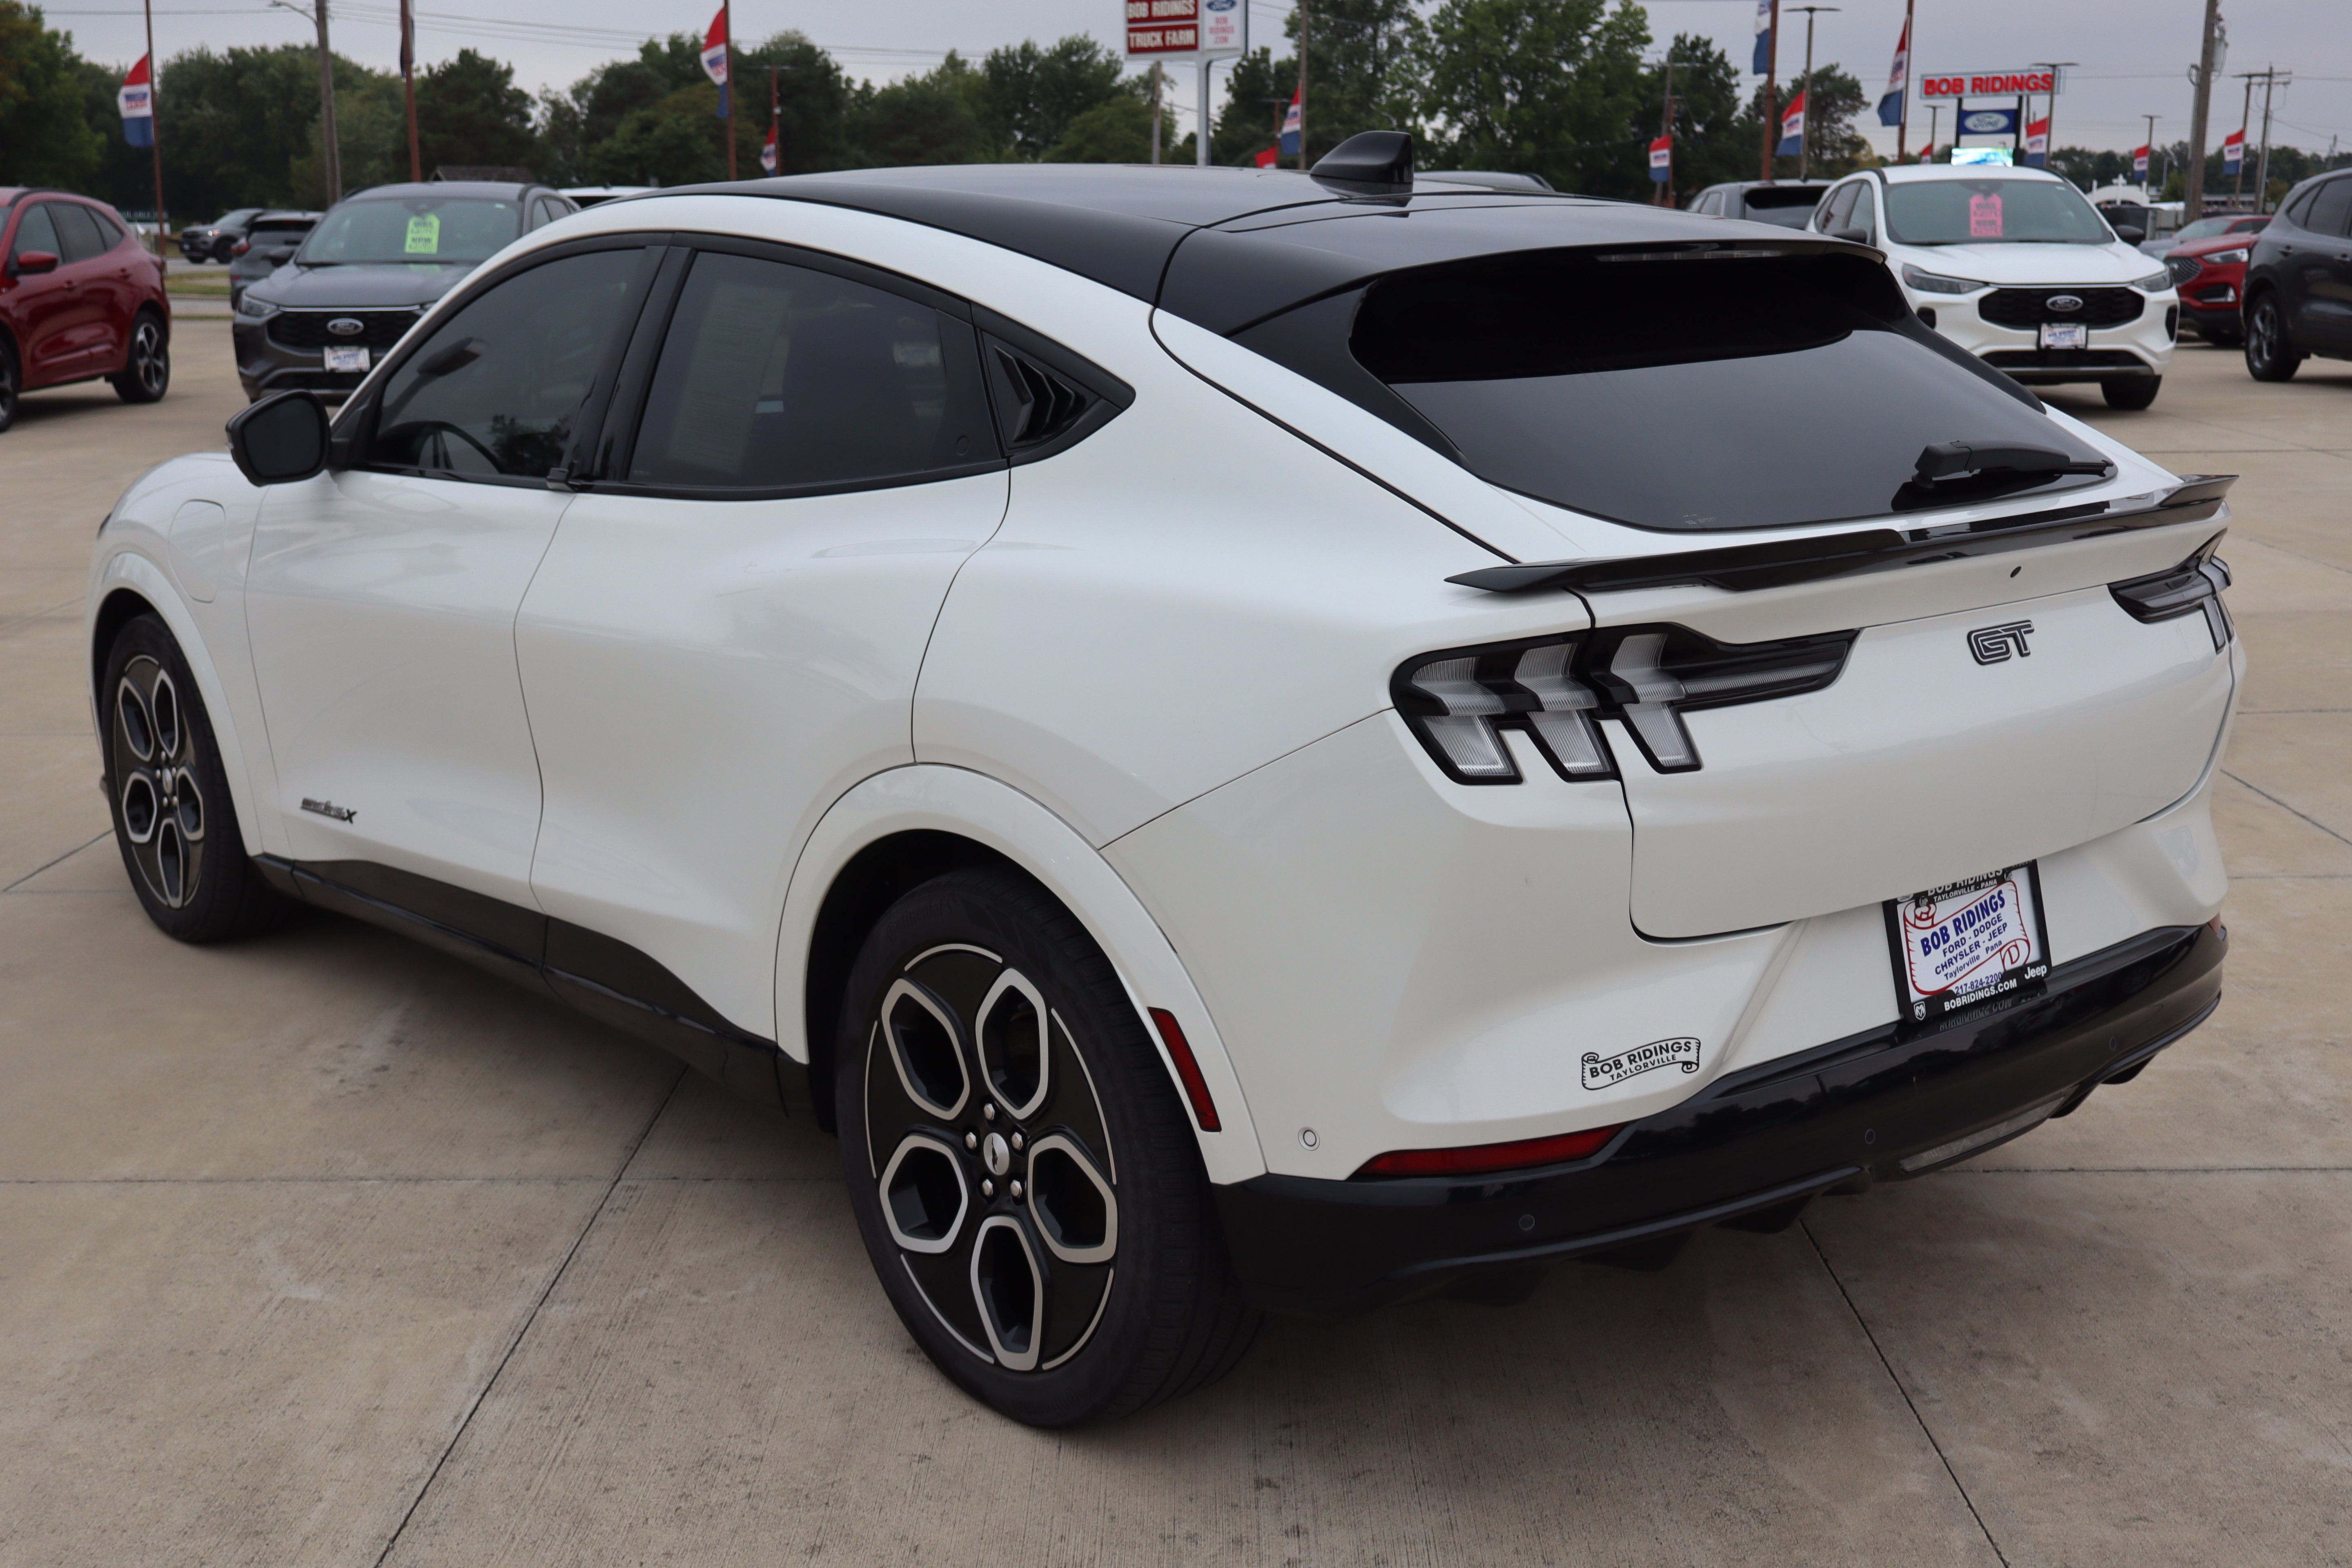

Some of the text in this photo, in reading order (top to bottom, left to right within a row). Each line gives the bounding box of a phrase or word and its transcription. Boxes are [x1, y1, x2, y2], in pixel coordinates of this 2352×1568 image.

[1128, 0, 1196, 19] BOB RIDINGS
[1129, 29, 1196, 48] TRUCK FARM
[1924, 73, 2053, 96] BOB RIDINGS
[1967, 619, 2034, 666] GT
[1933, 885, 1975, 902] TAYLORVILLE
[1981, 878, 1997, 889] PANA
[1920, 889, 2005, 957] BOB RIDINGS
[1942, 936, 1966, 958] FORD
[1973, 913, 2003, 938] DODGE
[1935, 940, 1981, 975] CHRYSLER
[1988, 922, 2007, 942] JEEP
[1944, 940, 2002, 981] Taylorville Pana
[1955, 971, 2003, 996] 217-824-2200
[2024, 964, 2047, 980] Jeep
[1944, 978, 2017, 1011] BOBRIDINGS.COM
[1589, 1041, 1692, 1078] BOB RIDINGS
[1610, 1054, 1676, 1081] TAYLORVILLE
